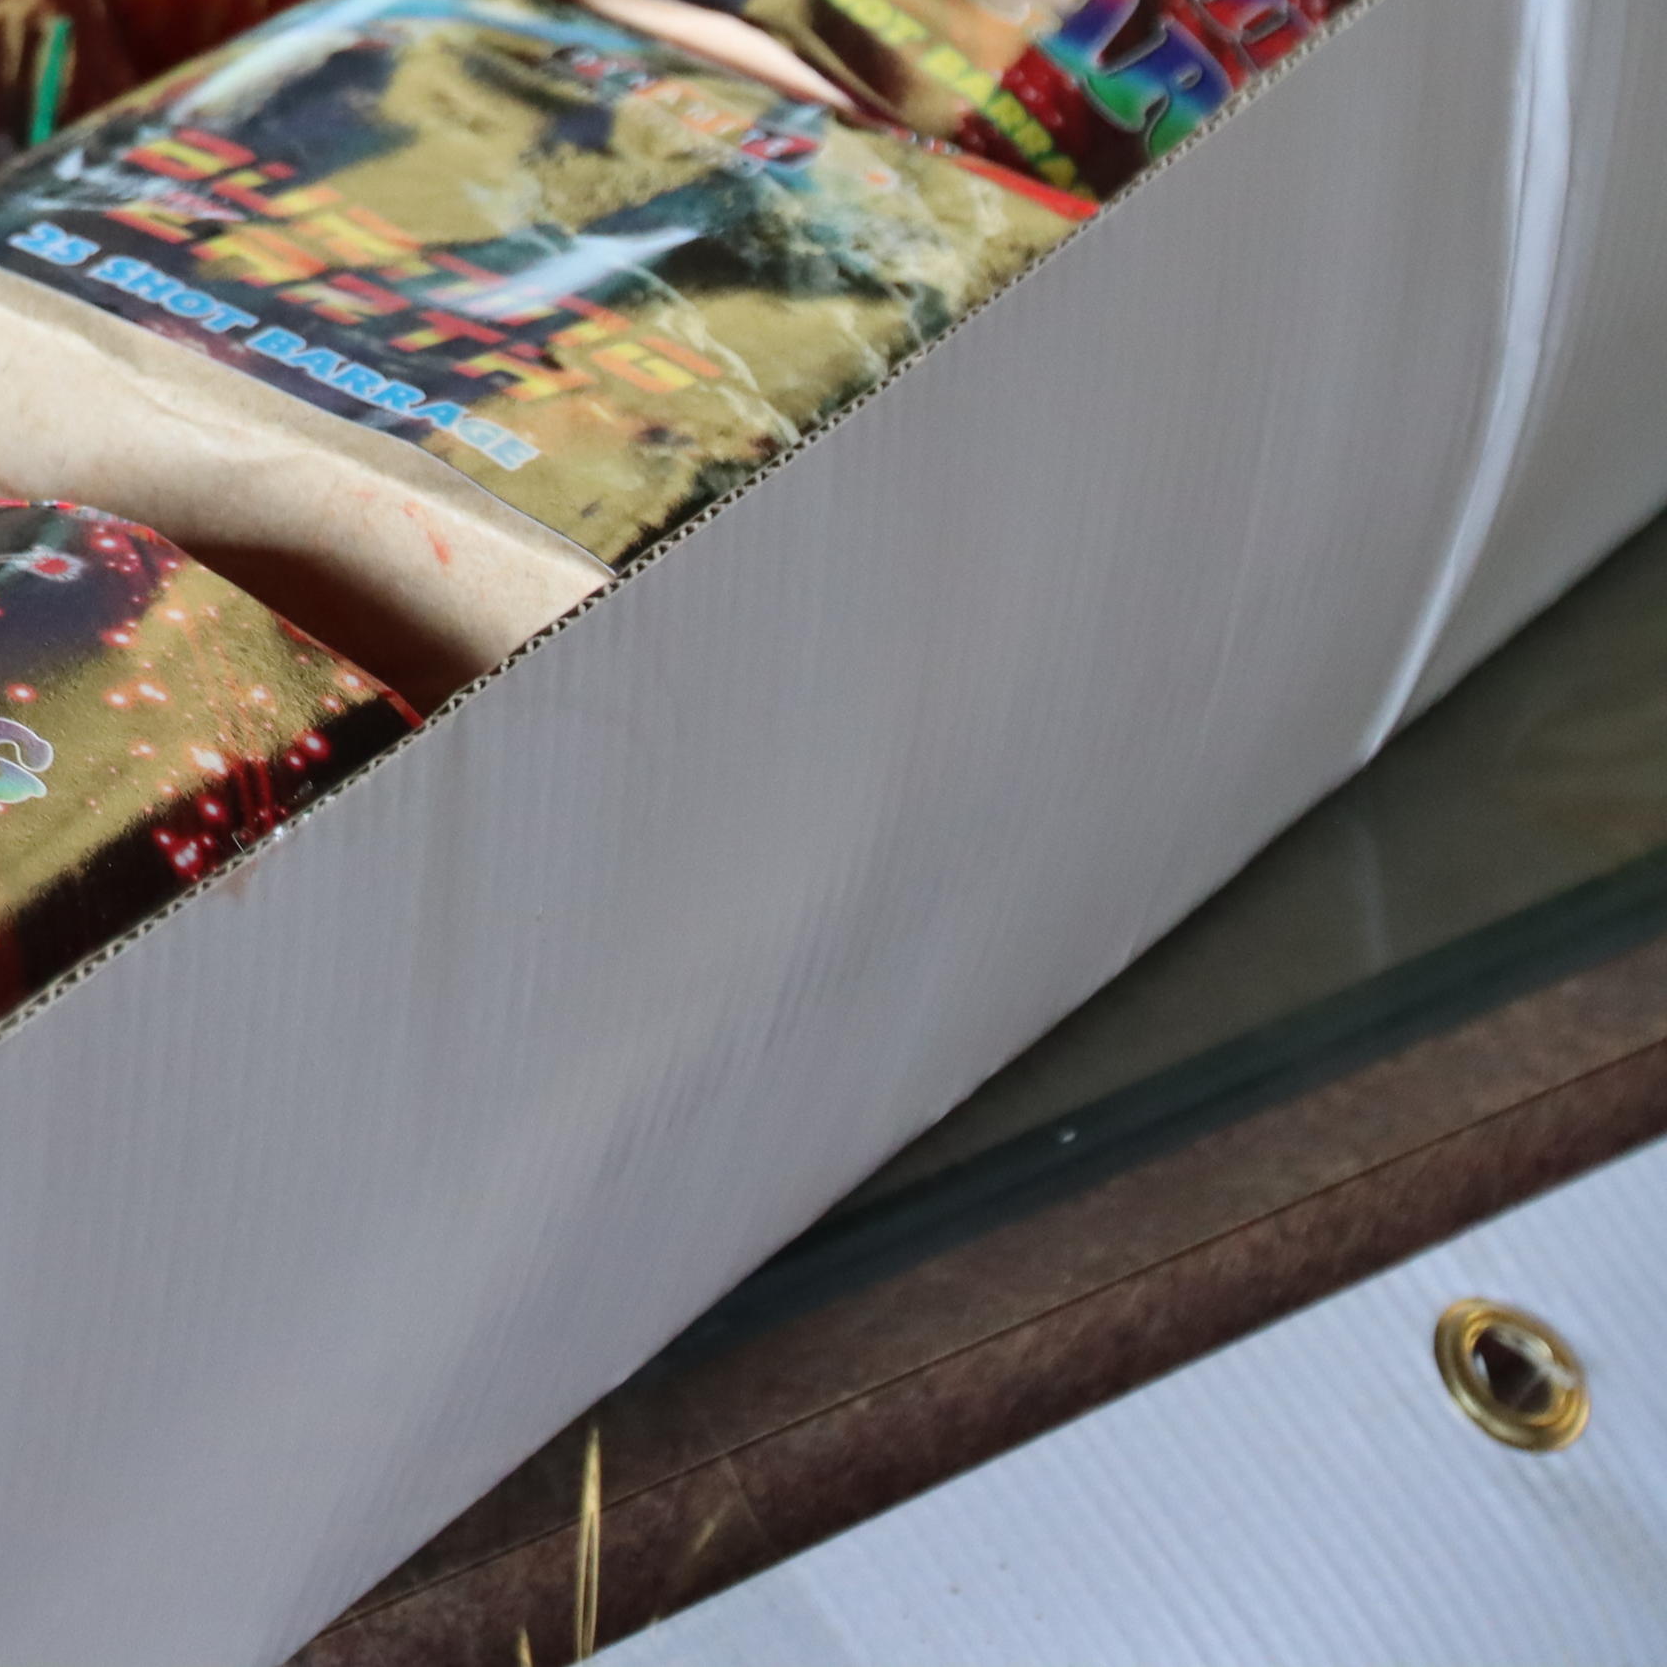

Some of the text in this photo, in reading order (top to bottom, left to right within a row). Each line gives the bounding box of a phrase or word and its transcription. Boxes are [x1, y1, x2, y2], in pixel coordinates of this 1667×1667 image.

[8, 221, 542, 472] 25 SHOT BARRAGE
